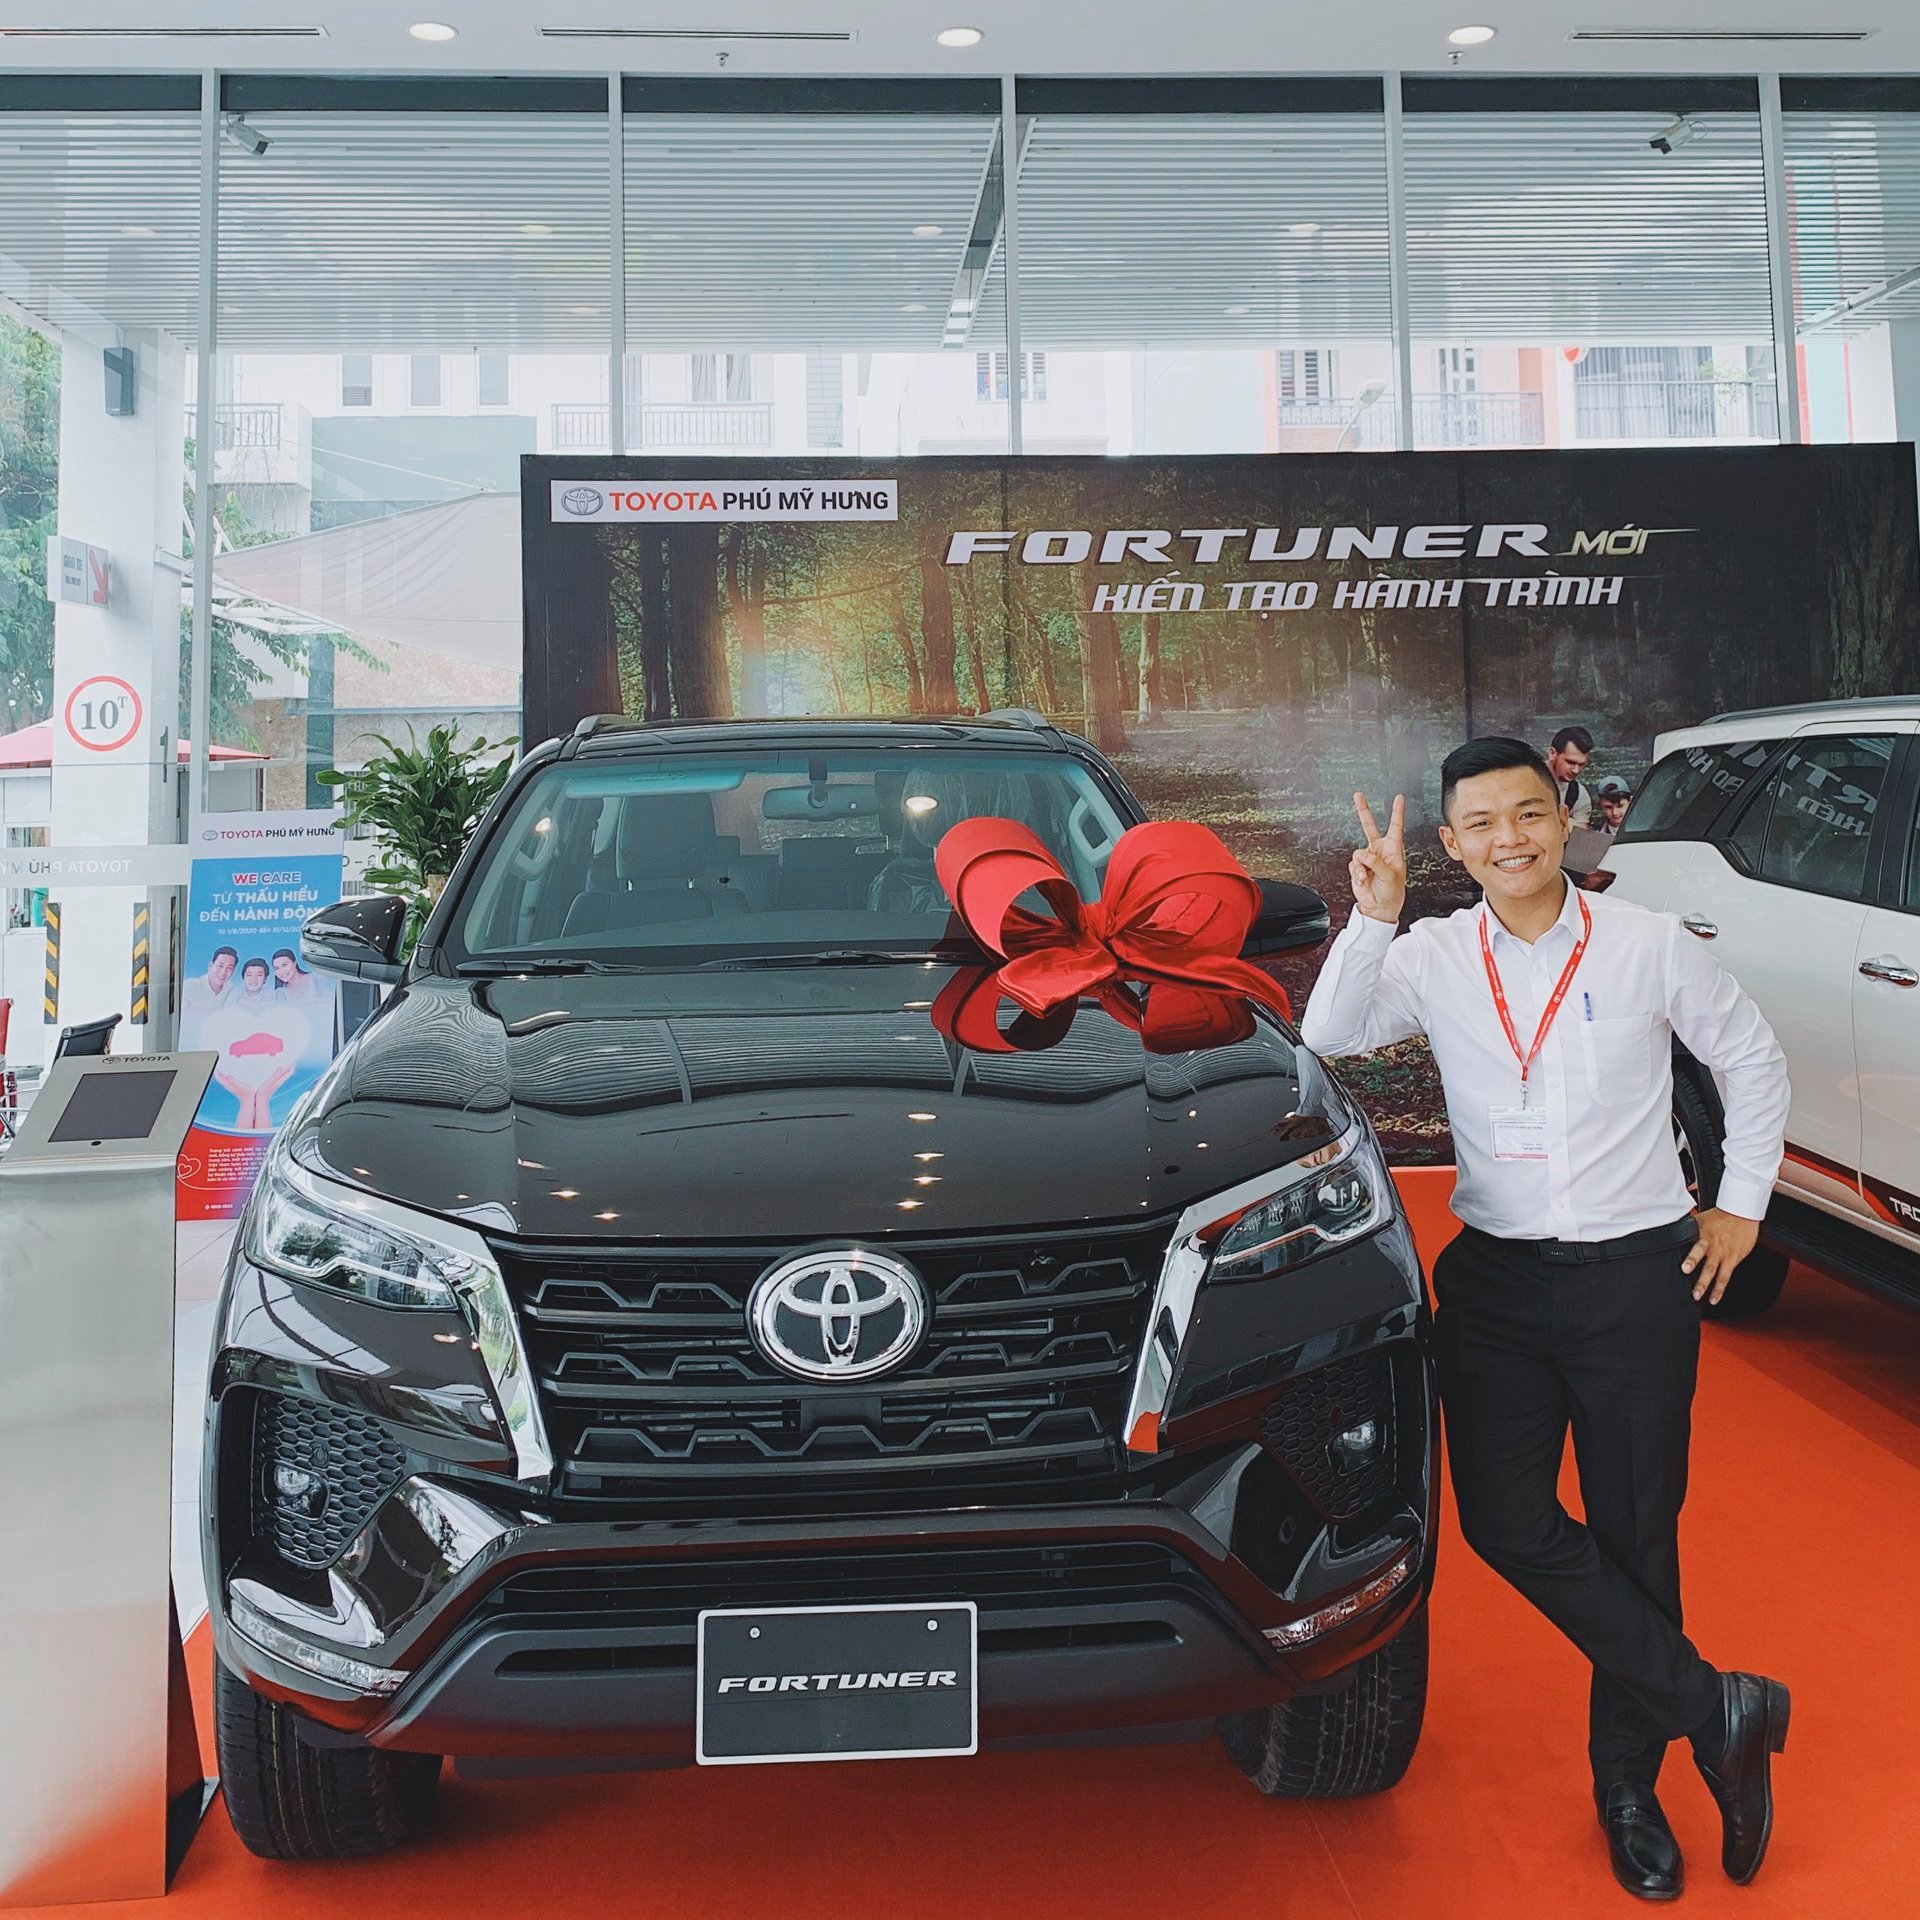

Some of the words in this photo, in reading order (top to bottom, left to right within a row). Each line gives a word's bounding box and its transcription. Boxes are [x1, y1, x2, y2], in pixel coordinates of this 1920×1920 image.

[609, 492, 718, 512] TOYOTA
[723, 487, 771, 510] PHÚ
[779, 487, 814, 510] MỸ
[821, 490, 888, 510] HƯNG
[945, 523, 1551, 565] FORTUNER
[1556, 523, 1656, 556] MỚI
[1092, 570, 1205, 613] KIẾN
[1222, 581, 1318, 620] TẠO
[1332, 573, 1464, 609] HÀNH
[1480, 570, 1624, 607] TRÌNH
[220, 829, 264, 840] TOYOTA
[266, 827, 287, 838] PHÚ
[289, 827, 304, 837] MỸ
[306, 826, 335, 836] HƯNG
[233, 873, 257, 885] WE
[261, 871, 302, 885] CARE
[212, 890, 233, 904] TỪ
[236, 887, 279, 904] THẤU
[282, 885, 318, 902] HIỂU
[200, 907, 230, 922] ĐẾN
[234, 905, 279, 921] HÀNH
[283, 905, 324, 921] ĐỘN
[717, 1670, 957, 1694] FORTUNER
